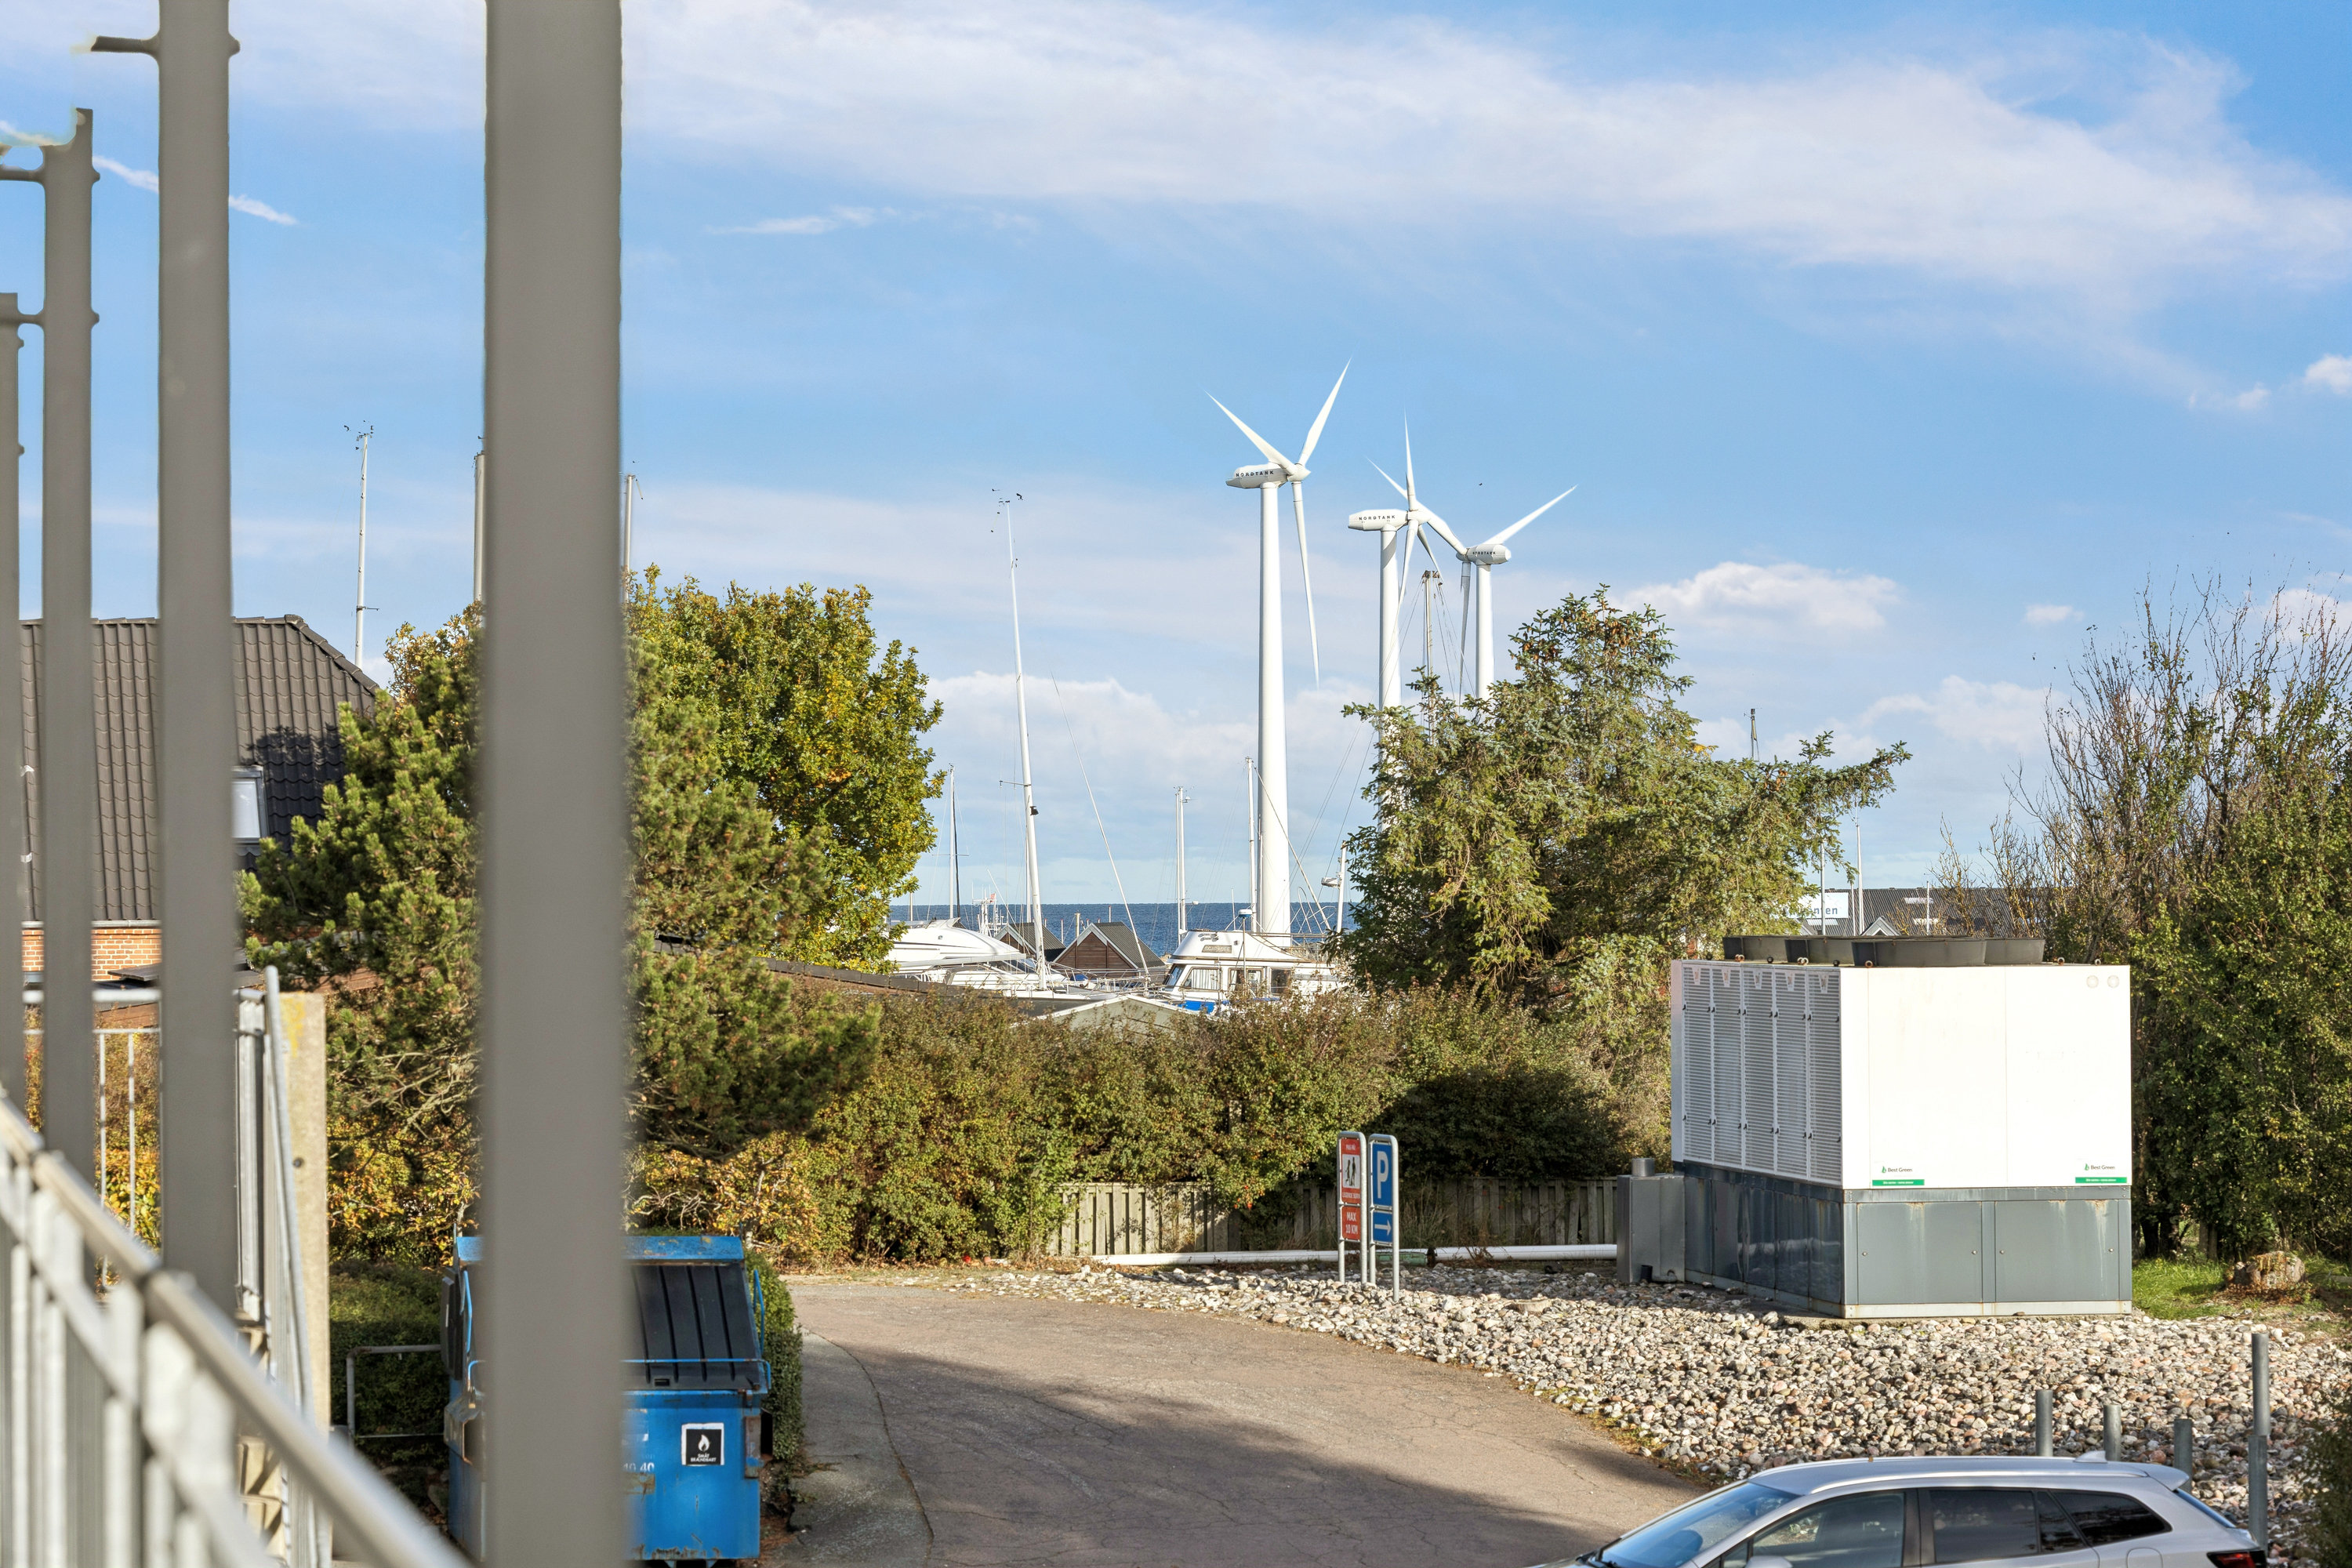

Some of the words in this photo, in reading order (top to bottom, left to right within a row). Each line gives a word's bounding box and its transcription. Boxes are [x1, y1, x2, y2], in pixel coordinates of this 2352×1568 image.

[1377, 1151, 1389, 1199] P
[1347, 1212, 1356, 1221] MAX
[1352, 1225, 1358, 1234] KM
